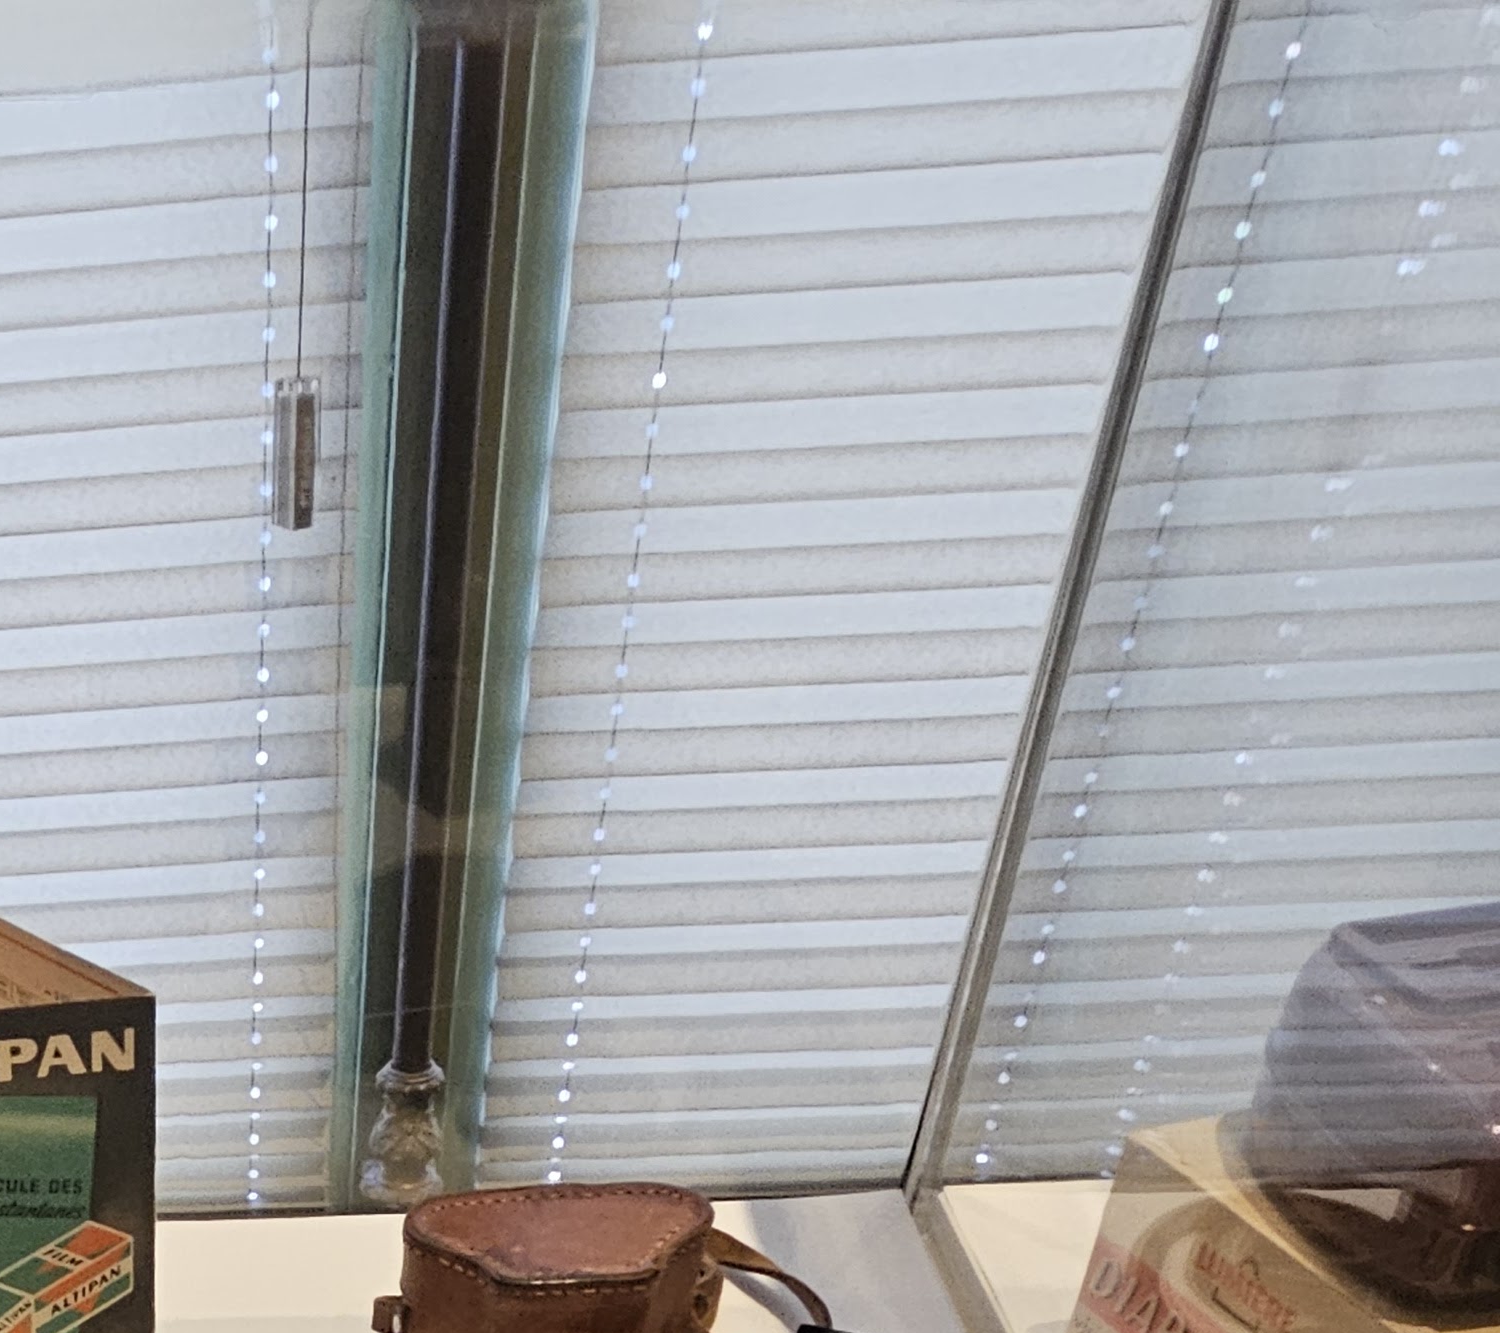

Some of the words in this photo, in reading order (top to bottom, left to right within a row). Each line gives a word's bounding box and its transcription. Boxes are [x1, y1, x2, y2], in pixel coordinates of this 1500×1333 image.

[49, 1177, 83, 1194] DES
[42, 1249, 83, 1267] FILM
[50, 1265, 122, 1316] ALTIPAN
